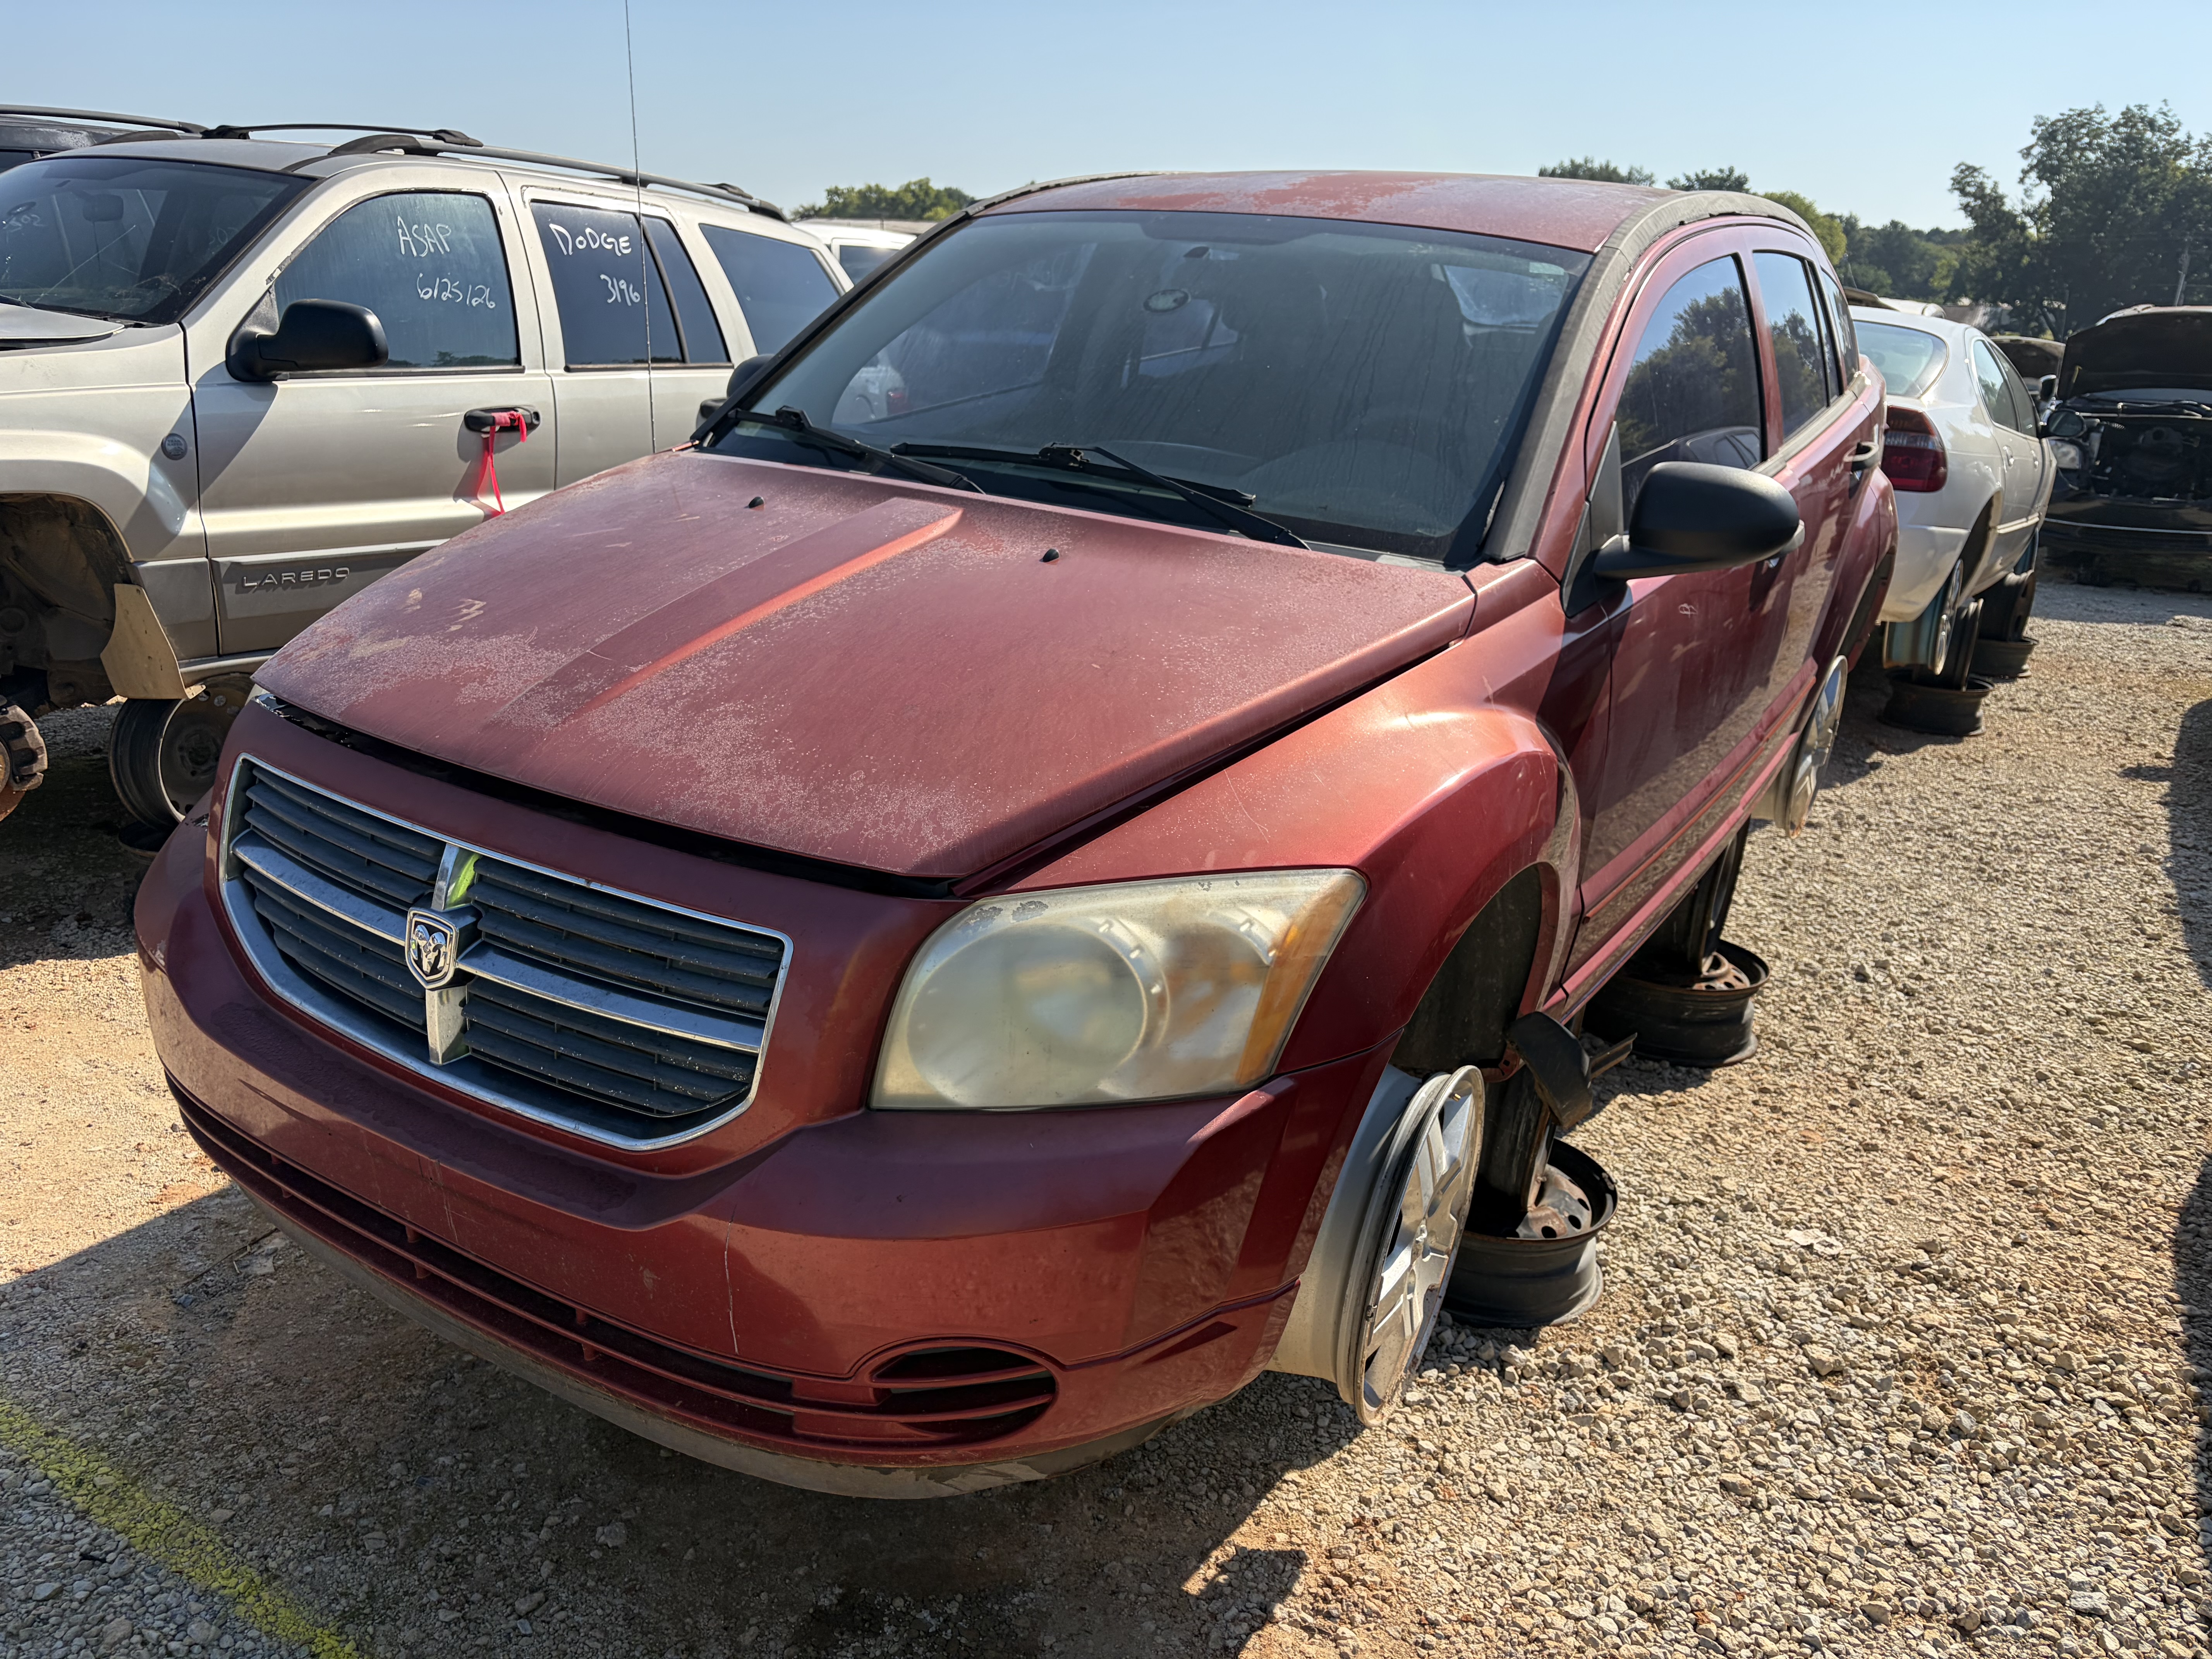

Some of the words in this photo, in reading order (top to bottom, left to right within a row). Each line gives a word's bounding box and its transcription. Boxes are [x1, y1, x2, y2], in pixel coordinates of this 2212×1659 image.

[397, 215, 452, 258] ASAP
[549, 223, 632, 256] DODGE
[600, 274, 641, 306] 3196
[244, 567, 350, 587] LAREDO
